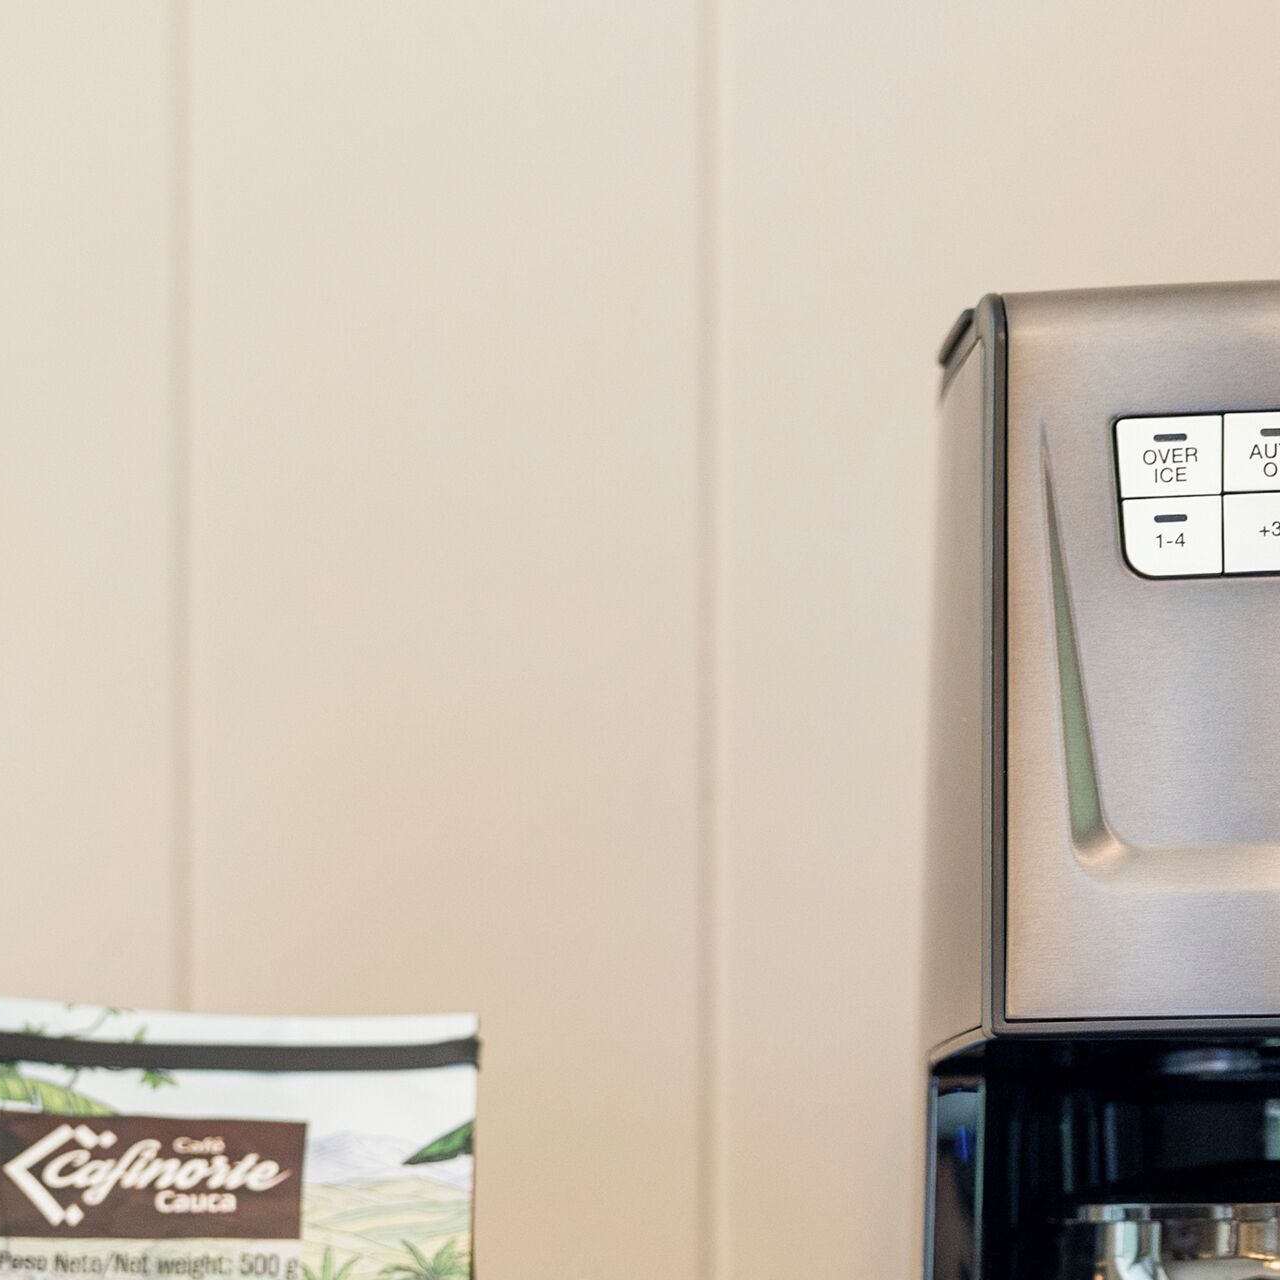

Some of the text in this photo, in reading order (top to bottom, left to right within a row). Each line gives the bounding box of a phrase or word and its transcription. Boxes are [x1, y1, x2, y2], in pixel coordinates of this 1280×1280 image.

[1141, 448, 1198, 466] OVER
[1153, 468, 1189, 484] ICE
[1154, 532, 1187, 550] 1-4
[41, 1139, 292, 1206] Cafinorte
[154, 1190, 237, 1213] Cauca
[157, 1255, 233, 1280] weight:
[239, 1253, 280, 1276] 500
[285, 1260, 299, 1280] g
